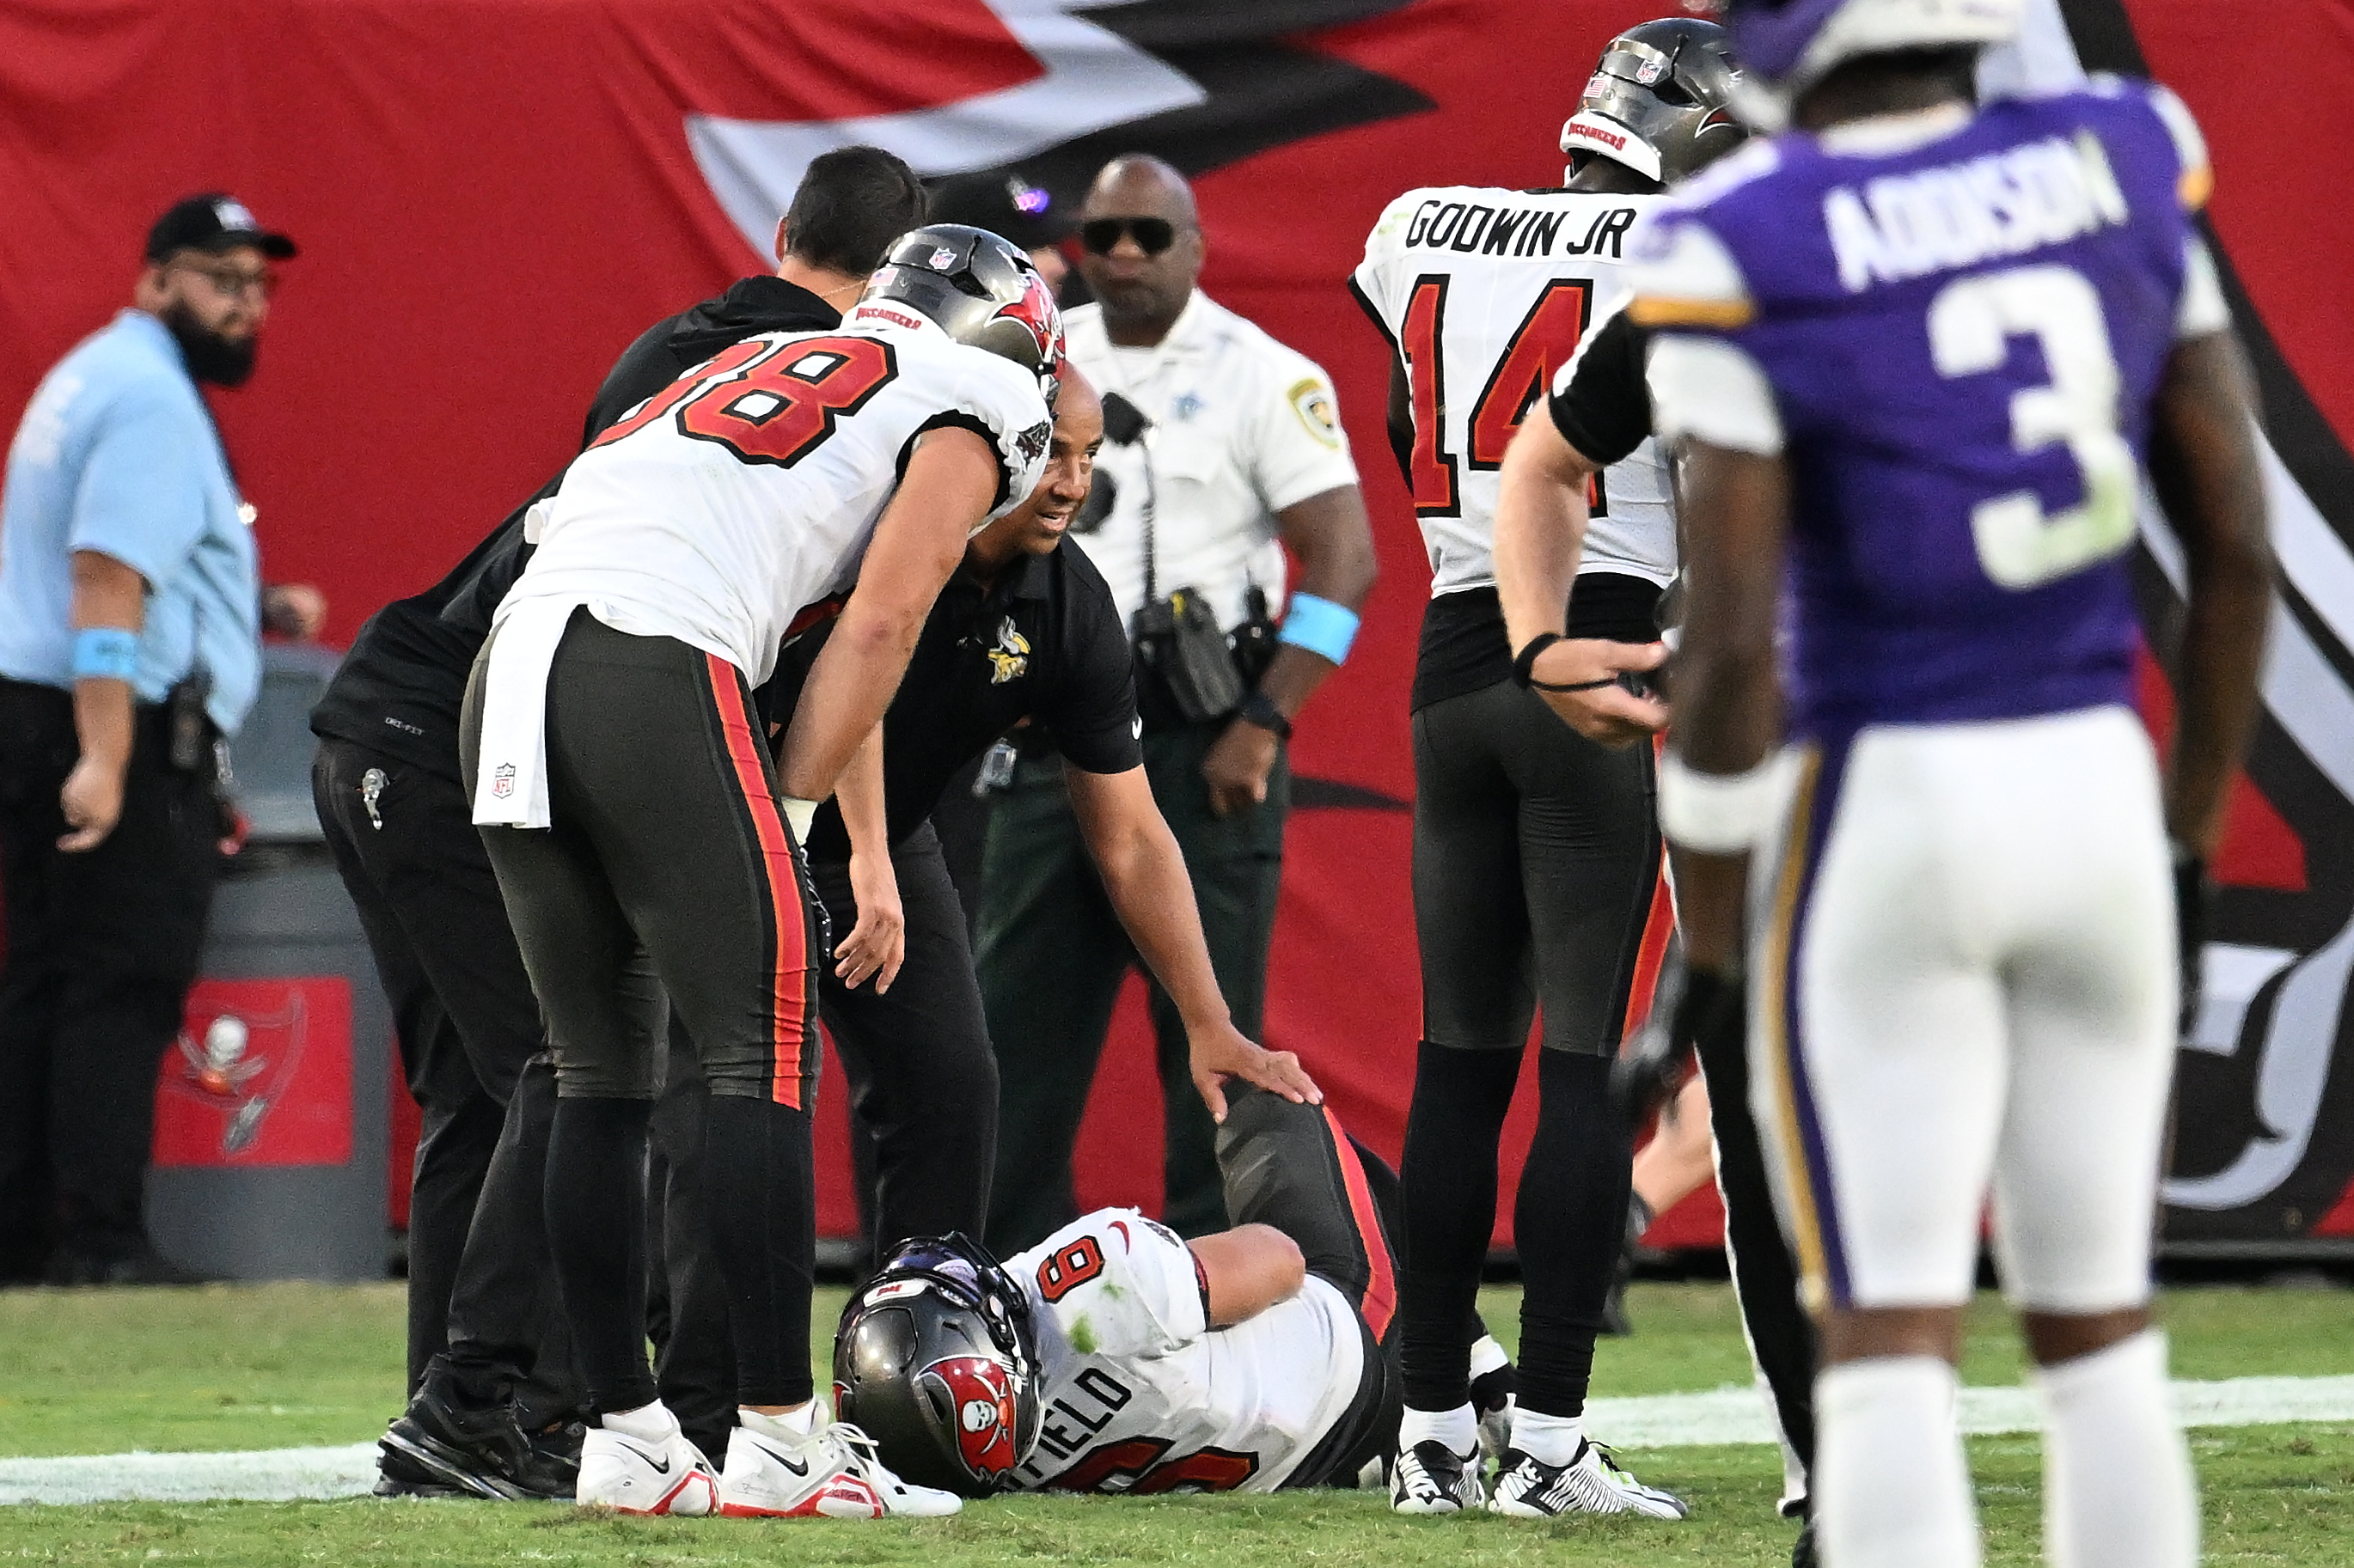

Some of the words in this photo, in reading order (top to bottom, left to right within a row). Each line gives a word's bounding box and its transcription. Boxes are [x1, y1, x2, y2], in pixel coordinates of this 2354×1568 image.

[1406, 200, 1570, 257] GODWIN
[1566, 208, 1637, 259] JR
[1401, 273, 1609, 519] 14
[1926, 265, 2141, 592] 3
